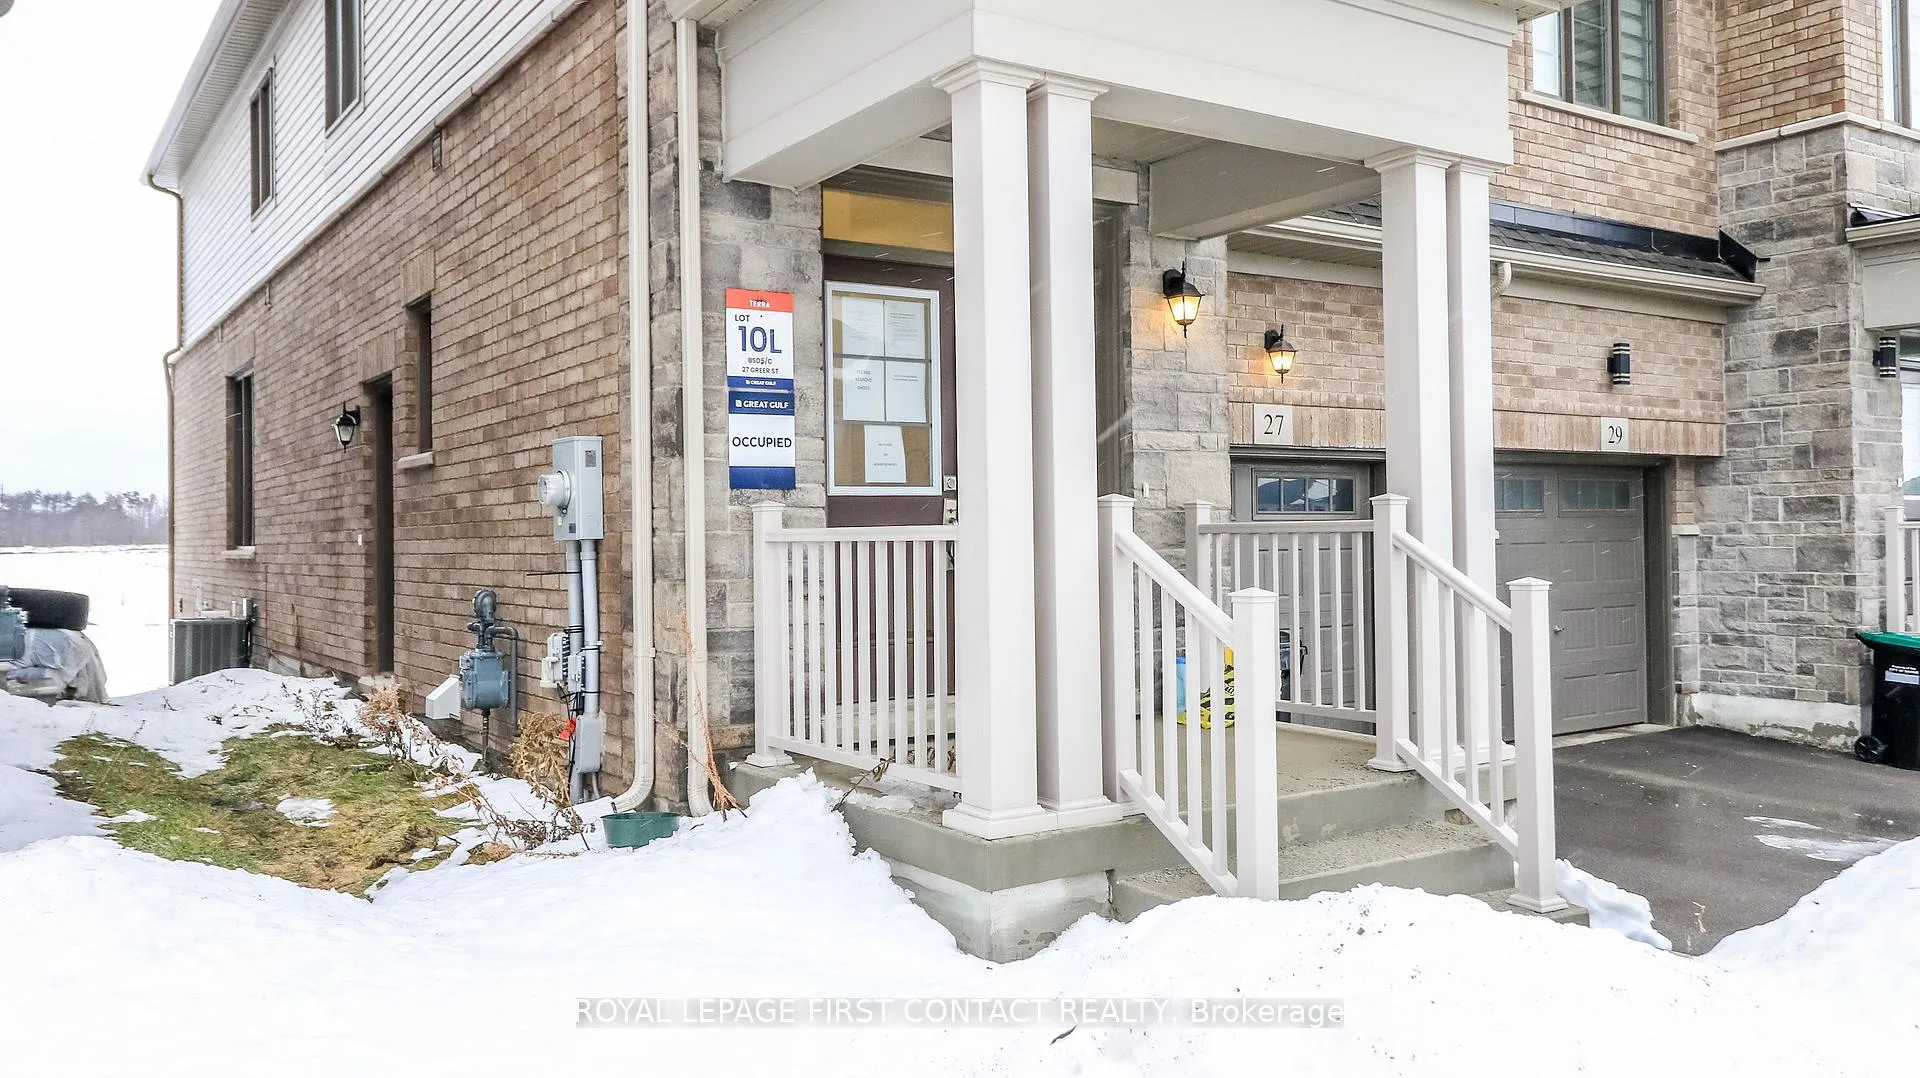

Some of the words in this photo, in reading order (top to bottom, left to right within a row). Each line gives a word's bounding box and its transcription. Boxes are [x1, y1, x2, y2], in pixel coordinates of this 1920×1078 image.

[749, 300, 771, 308] TERRA
[735, 314, 750, 322] LOT
[738, 325, 782, 354] 10L
[743, 400, 769, 408] GREAT
[769, 401, 789, 409] GULF
[1264, 414, 1284, 436] 27
[1608, 425, 1623, 445] 29
[732, 436, 792, 448] OCCUPIED
